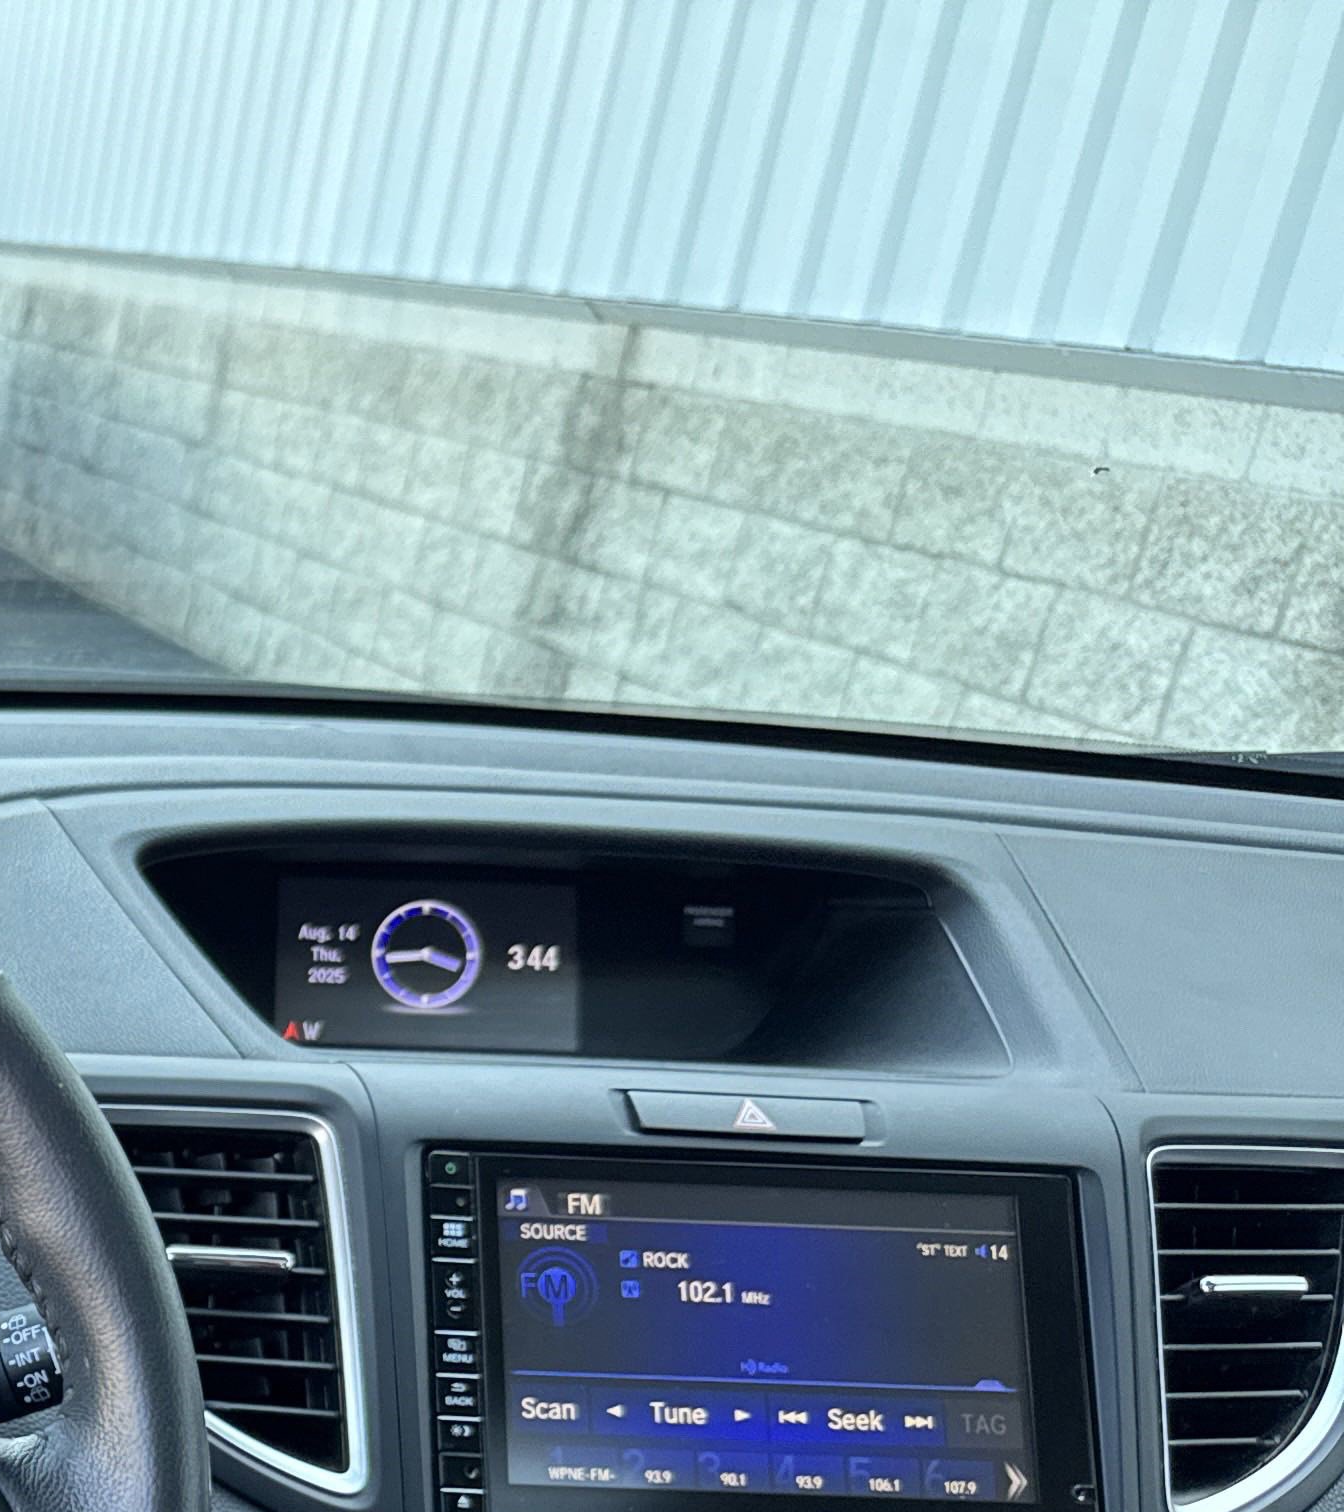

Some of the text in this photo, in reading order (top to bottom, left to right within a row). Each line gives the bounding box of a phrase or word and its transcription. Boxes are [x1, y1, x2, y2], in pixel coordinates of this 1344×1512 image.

[308, 967, 346, 984] 2025
[567, 1193, 601, 1215] FM
[520, 1223, 587, 1241] SOURCE
[438, 1238, 468, 1248] HOME
[642, 1252, 689, 1269] ROCK
[990, 1245, 1008, 1260] 14
[678, 1280, 771, 1305] 102.1 MHz
[11, 1325, 41, 1346] OFF
[15, 1347, 41, 1366] INT
[443, 1353, 473, 1363] MENU
[24, 1370, 49, 1388] ON
[521, 1397, 576, 1420] Scan
[649, 1401, 708, 1424] Tune
[827, 1408, 885, 1432] Seek
[961, 1413, 1007, 1435] TAG
[645, 1470, 672, 1483] 93.9
[795, 1475, 823, 1489] 93.9
